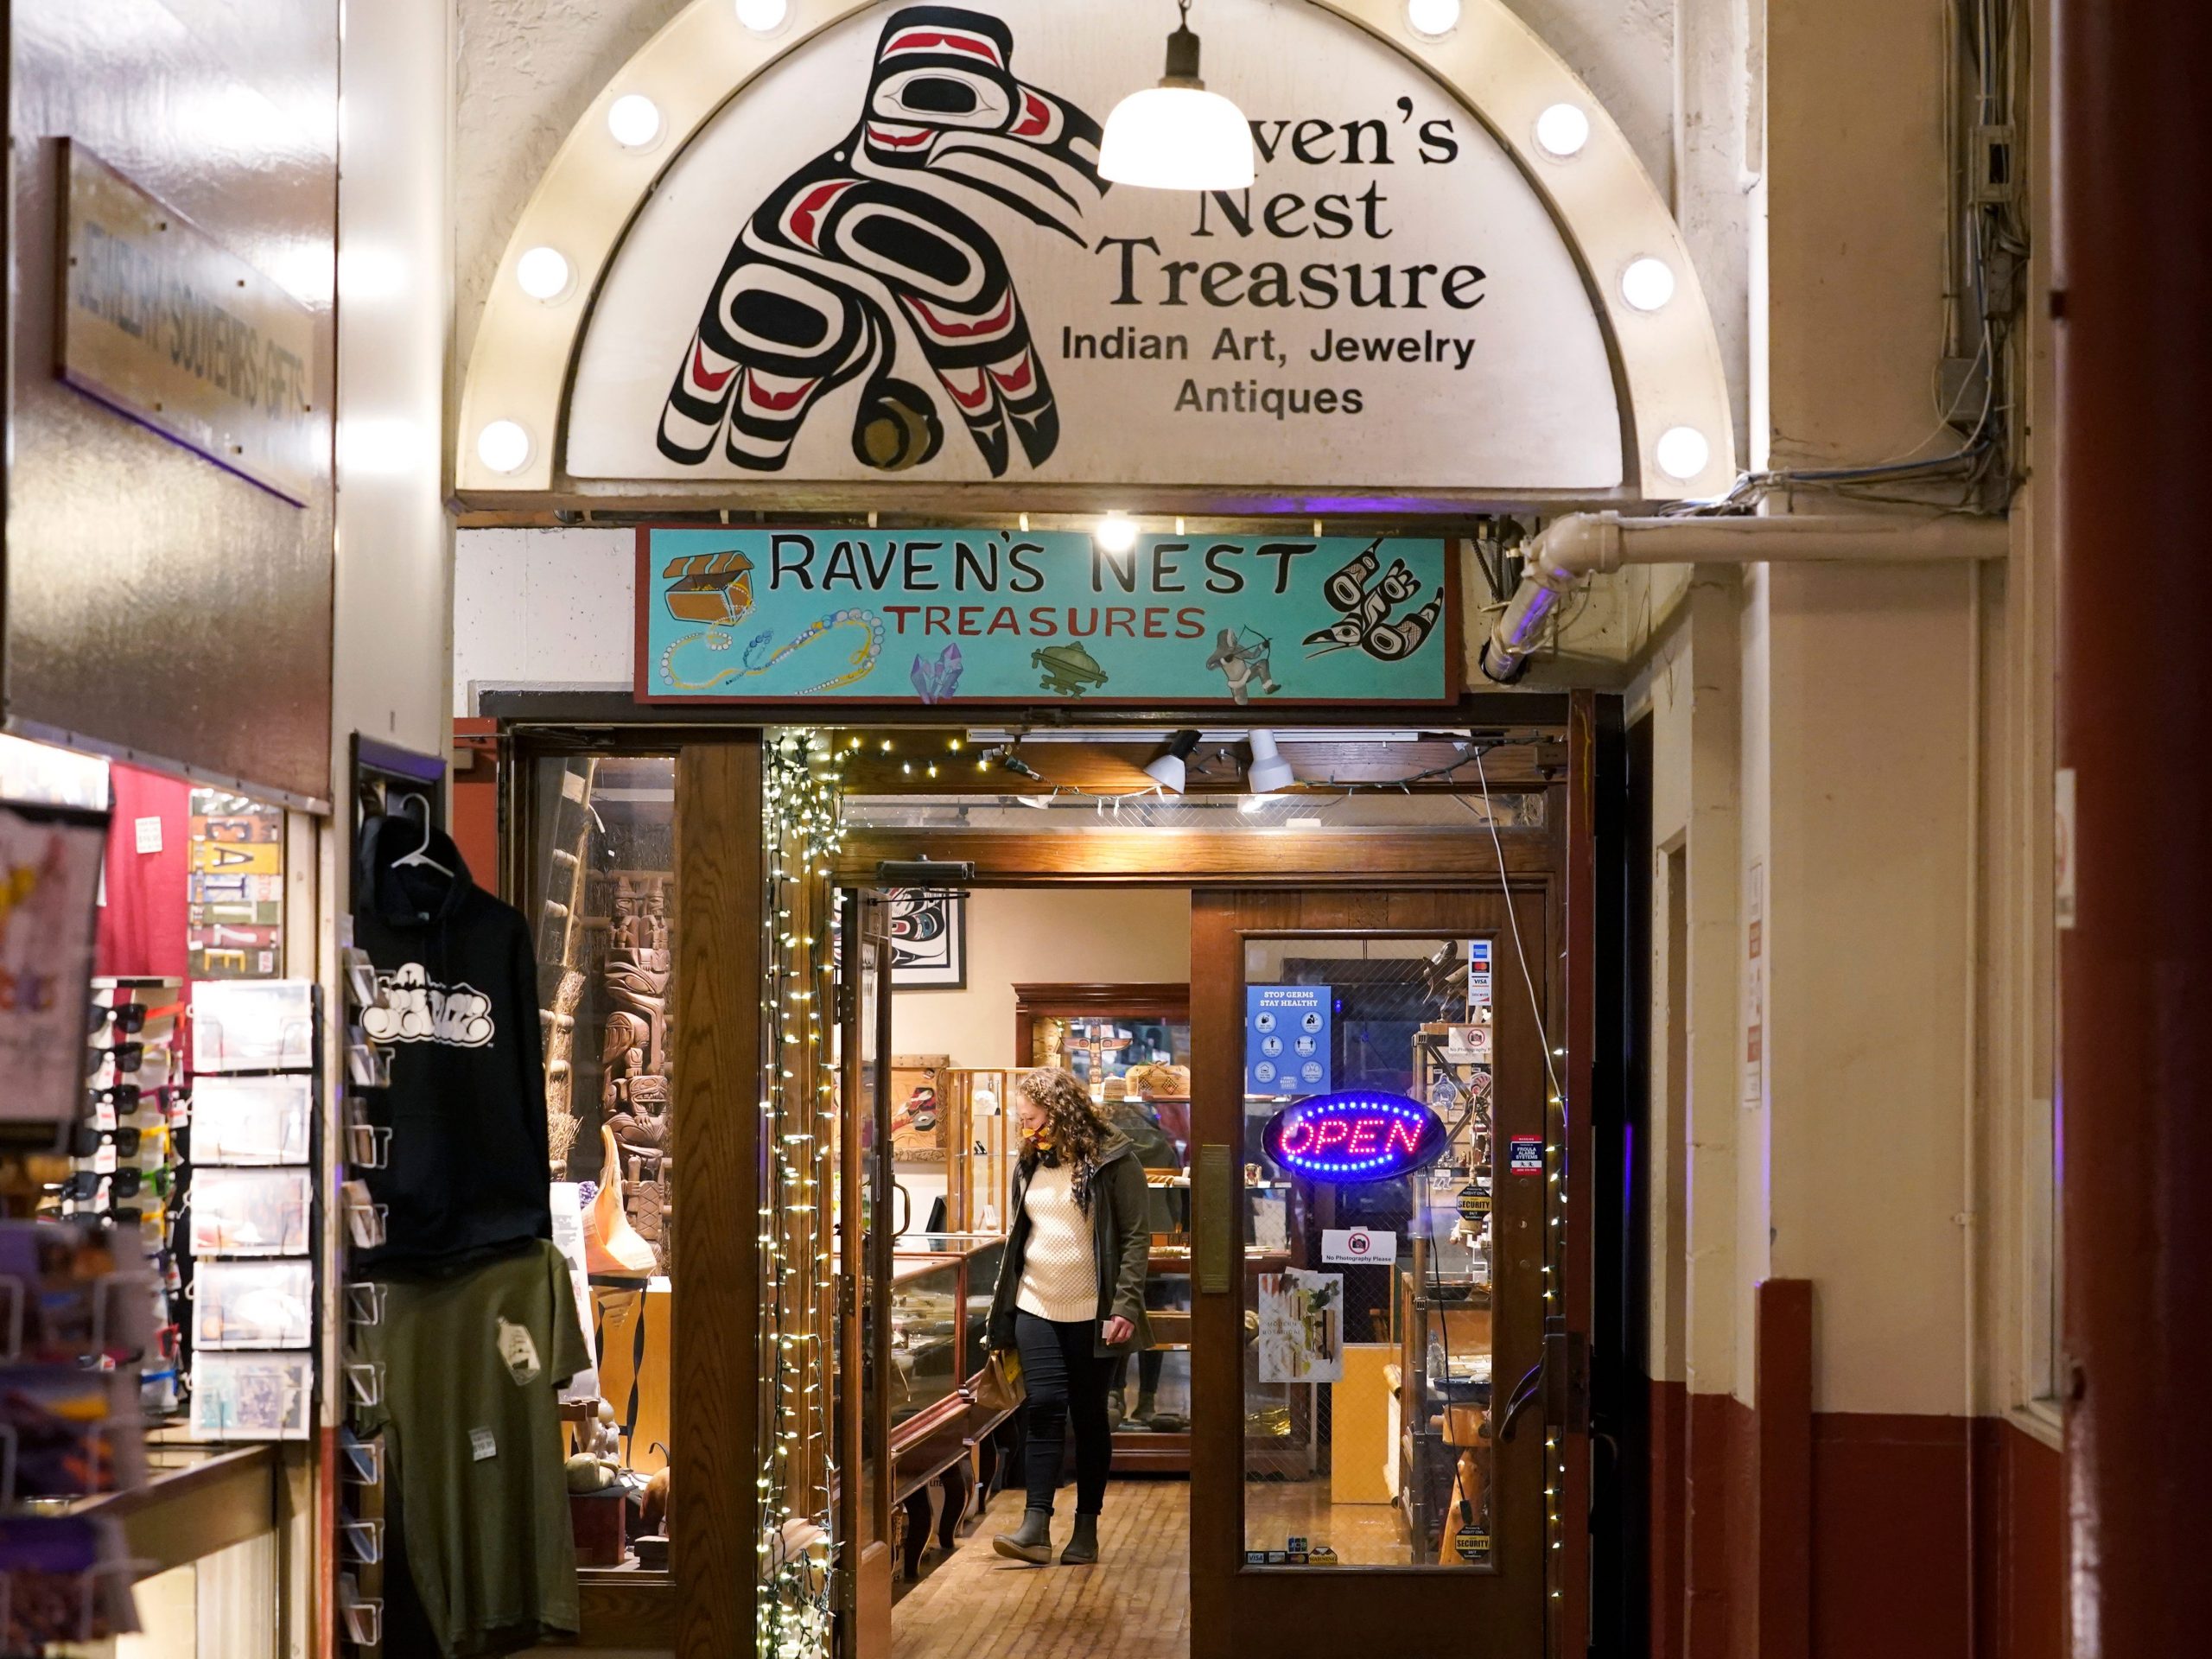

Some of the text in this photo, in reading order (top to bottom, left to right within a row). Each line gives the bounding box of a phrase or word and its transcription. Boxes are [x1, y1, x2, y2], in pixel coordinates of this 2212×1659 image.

[1252, 96, 1459, 164] ven's
[1191, 175, 1393, 239] Nest
[1095, 236, 1487, 310] Treasure
[1062, 327, 1476, 371] Indian Art, Jewelry
[1173, 378, 1363, 421] Antiques
[770, 530, 1318, 594] RAVEN'S NEST
[882, 605, 1206, 639] TREASURES
[1281, 1119, 1423, 1154] OPEN
[1458, 1200, 1491, 1209] SECURITY
